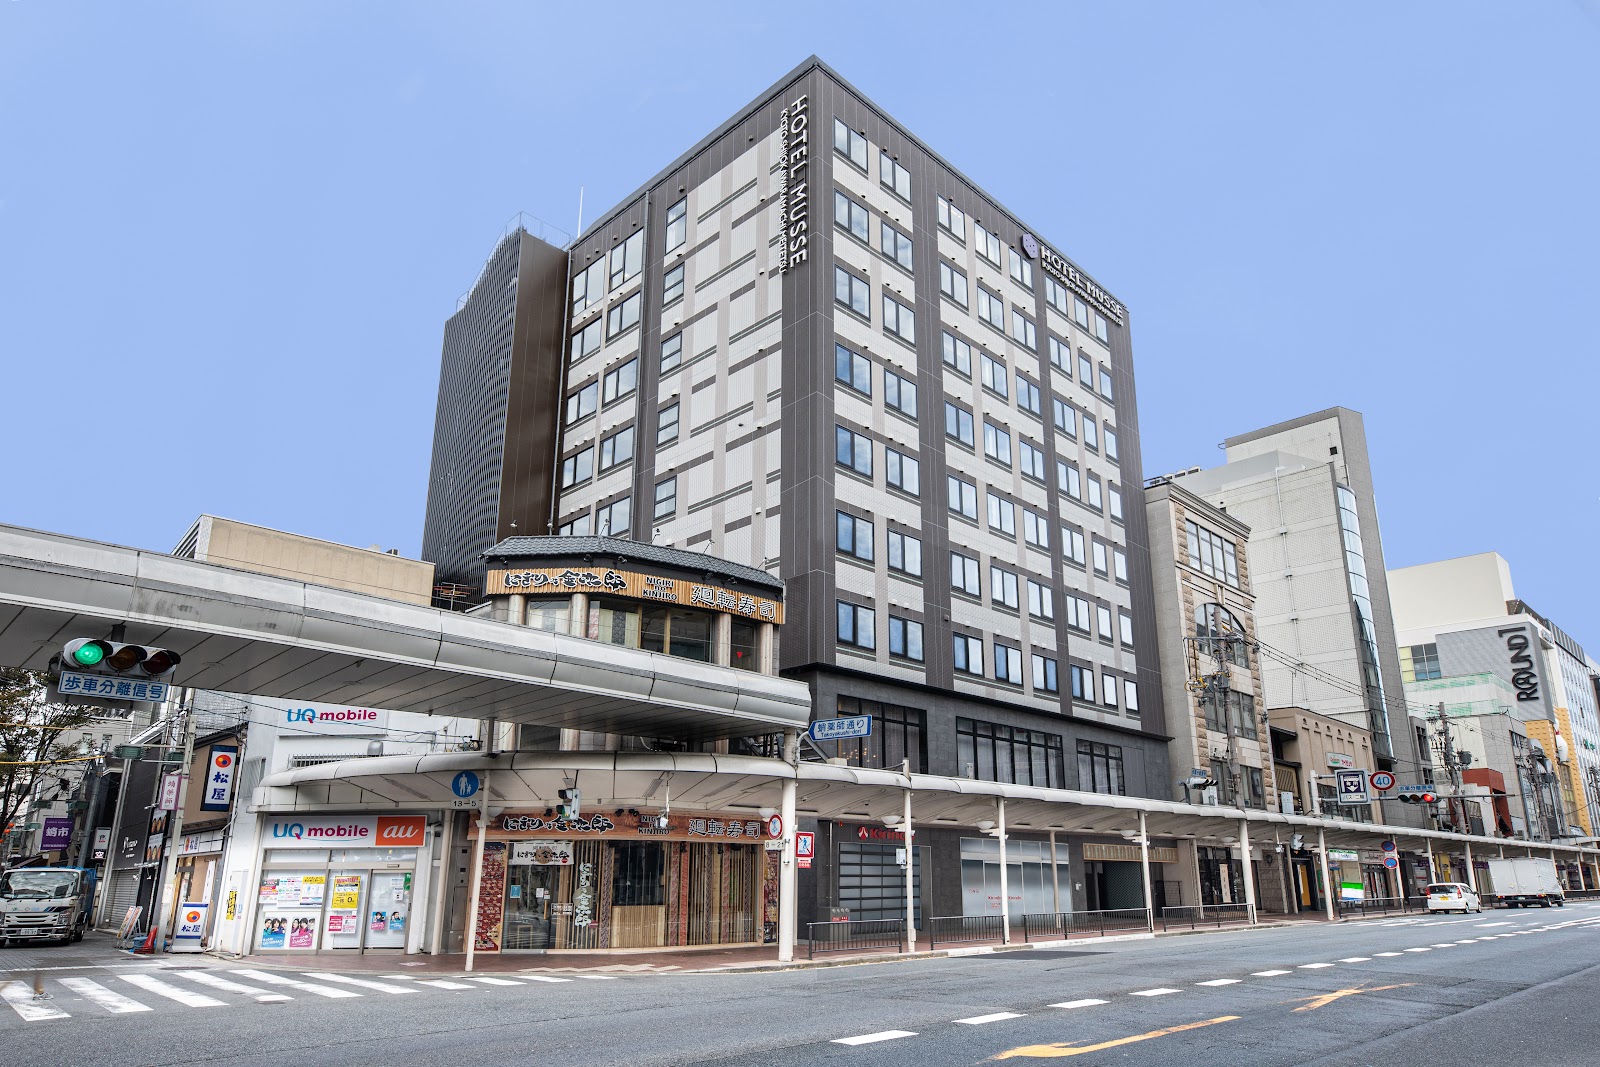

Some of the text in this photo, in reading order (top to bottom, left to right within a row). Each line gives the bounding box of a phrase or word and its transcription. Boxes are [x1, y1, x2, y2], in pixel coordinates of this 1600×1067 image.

[780, 108, 788, 138] KYOTO
[789, 94, 807, 268] HOTEL MUSSE
[1041, 246, 1123, 319] HOTEL MUSSE
[646, 576, 674, 588] NIGIRI
[642, 588, 677, 601] KINJIRO
[691, 585, 776, 620] 廻転寿司
[64, 676, 163, 699] 歩車分離信号
[287, 708, 377, 724] UQ mobile
[817, 719, 864, 733] 蛸薬師通り
[821, 729, 862, 738] Takoyakushi-dori
[211, 771, 229, 801] 松屋
[1375, 776, 1390, 786] 40
[273, 822, 369, 840] UQ mobile
[382, 823, 419, 839] au
[688, 818, 761, 839] 廻転寿司
[181, 924, 201, 933] 松屋
